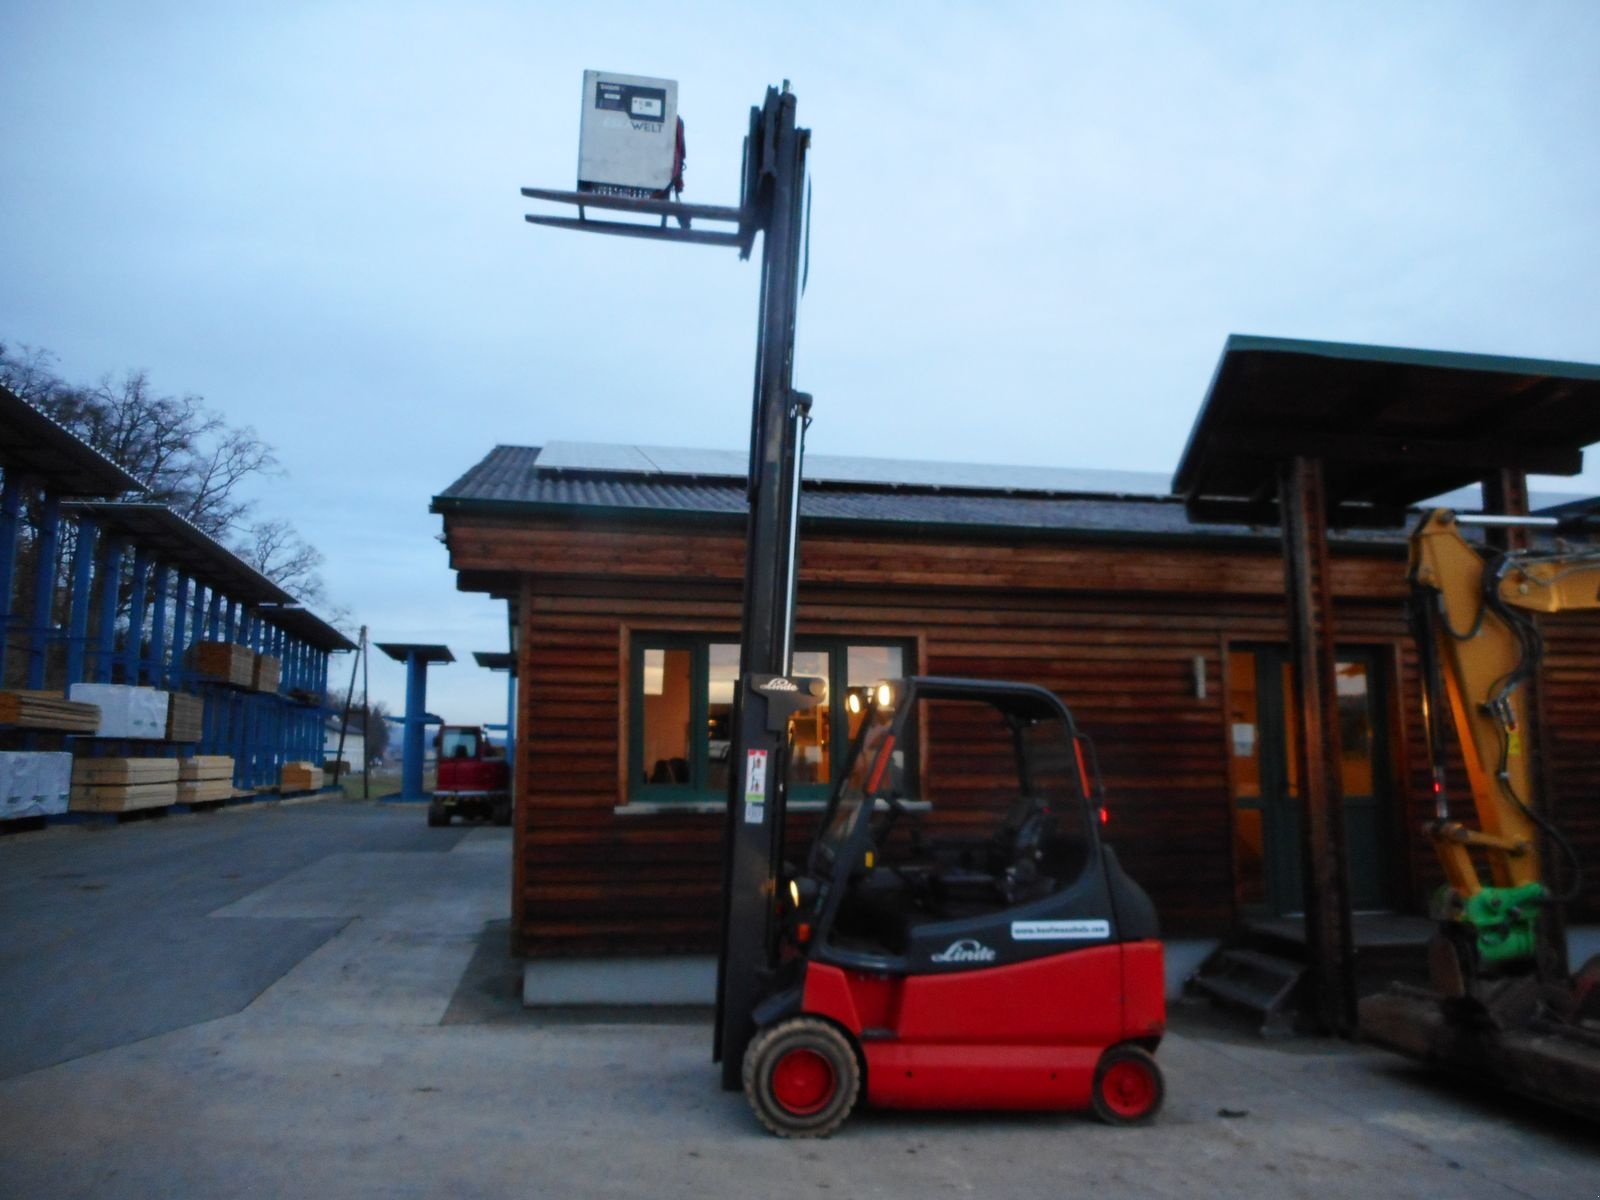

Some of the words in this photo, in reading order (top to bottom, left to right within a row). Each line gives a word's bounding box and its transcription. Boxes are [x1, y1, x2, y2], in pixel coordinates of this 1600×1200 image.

[630, 120, 664, 133] WELT
[759, 678, 798, 691] Linde
[931, 940, 996, 963] Linde
